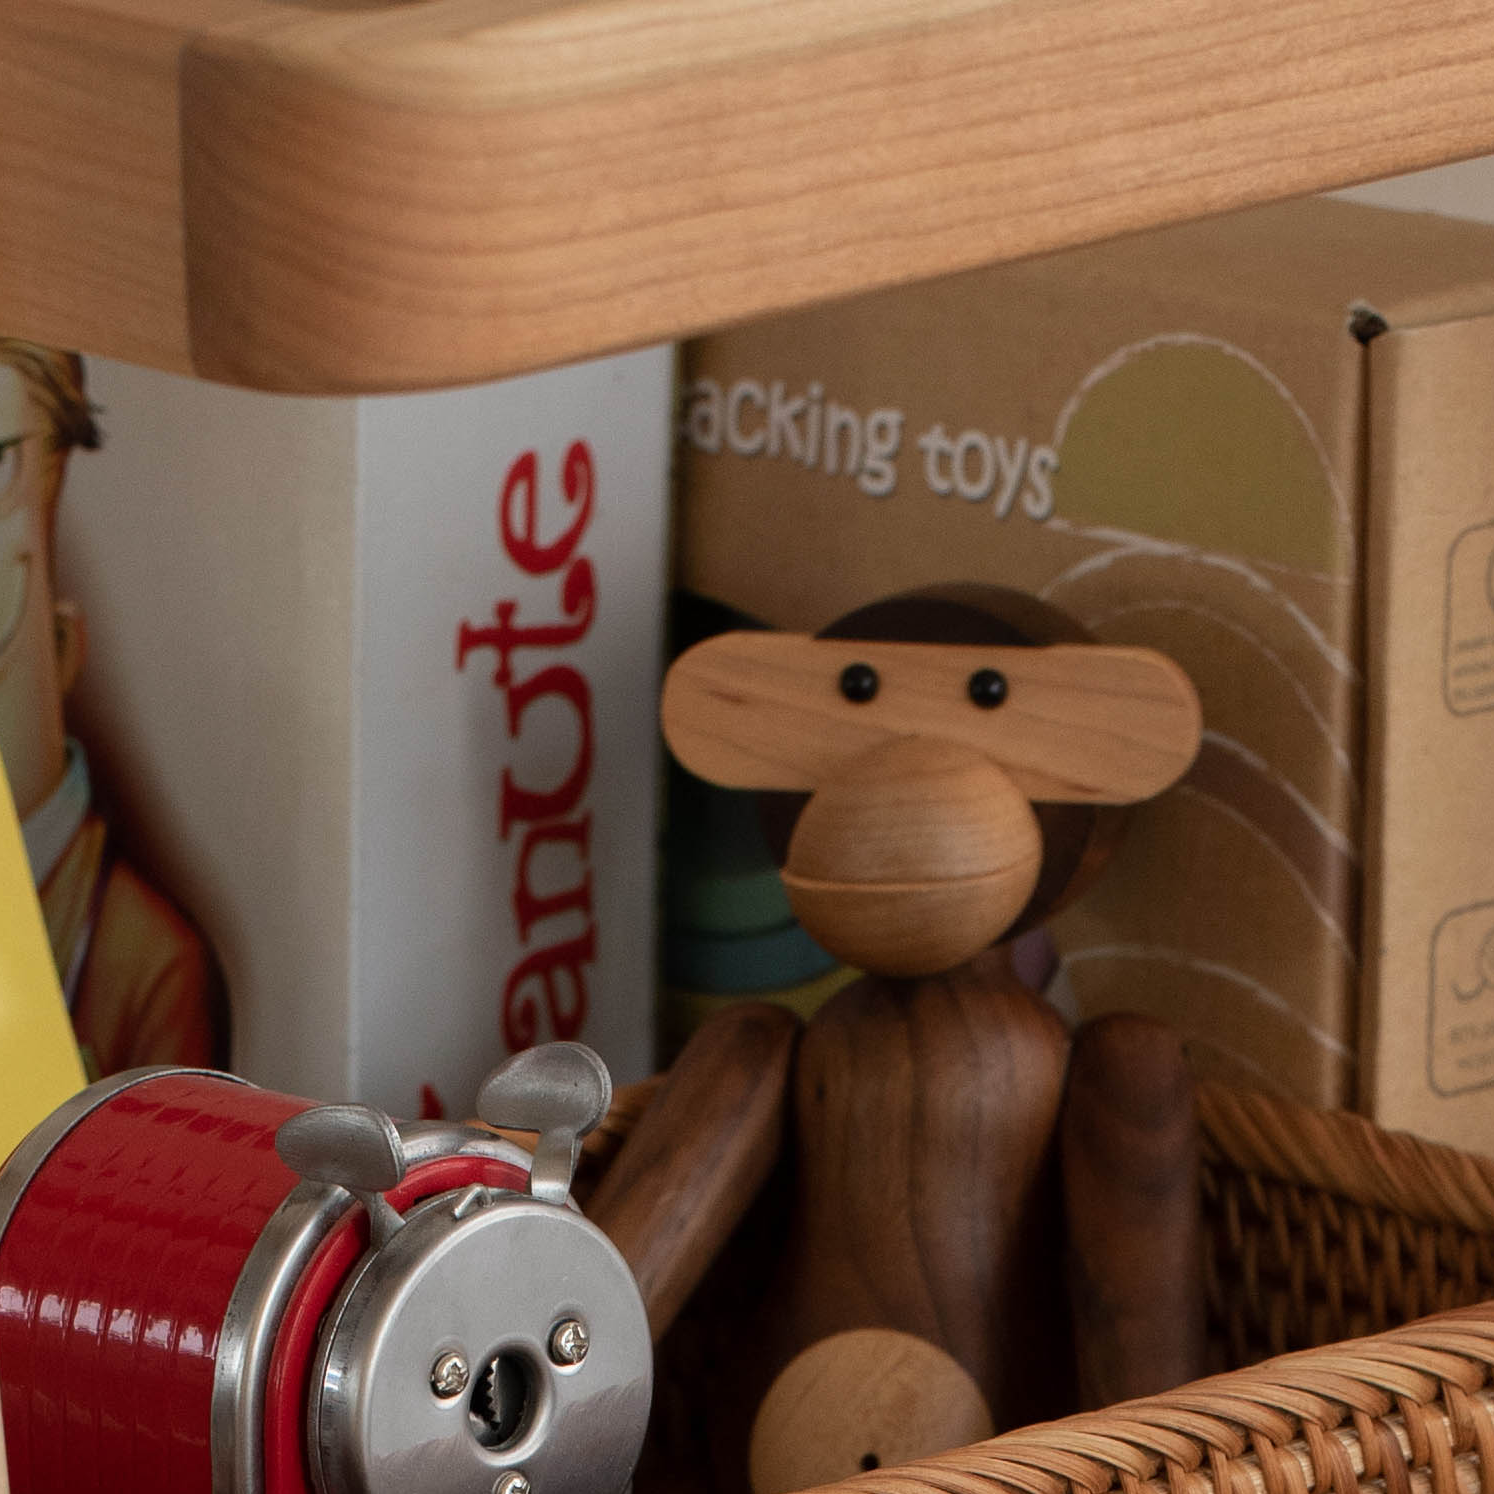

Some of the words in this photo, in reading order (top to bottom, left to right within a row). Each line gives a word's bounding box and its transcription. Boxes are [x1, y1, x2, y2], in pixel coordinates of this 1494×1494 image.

[677, 378, 905, 498] acking
[916, 423, 1060, 522] toys
[415, 438, 600, 1122] anute
